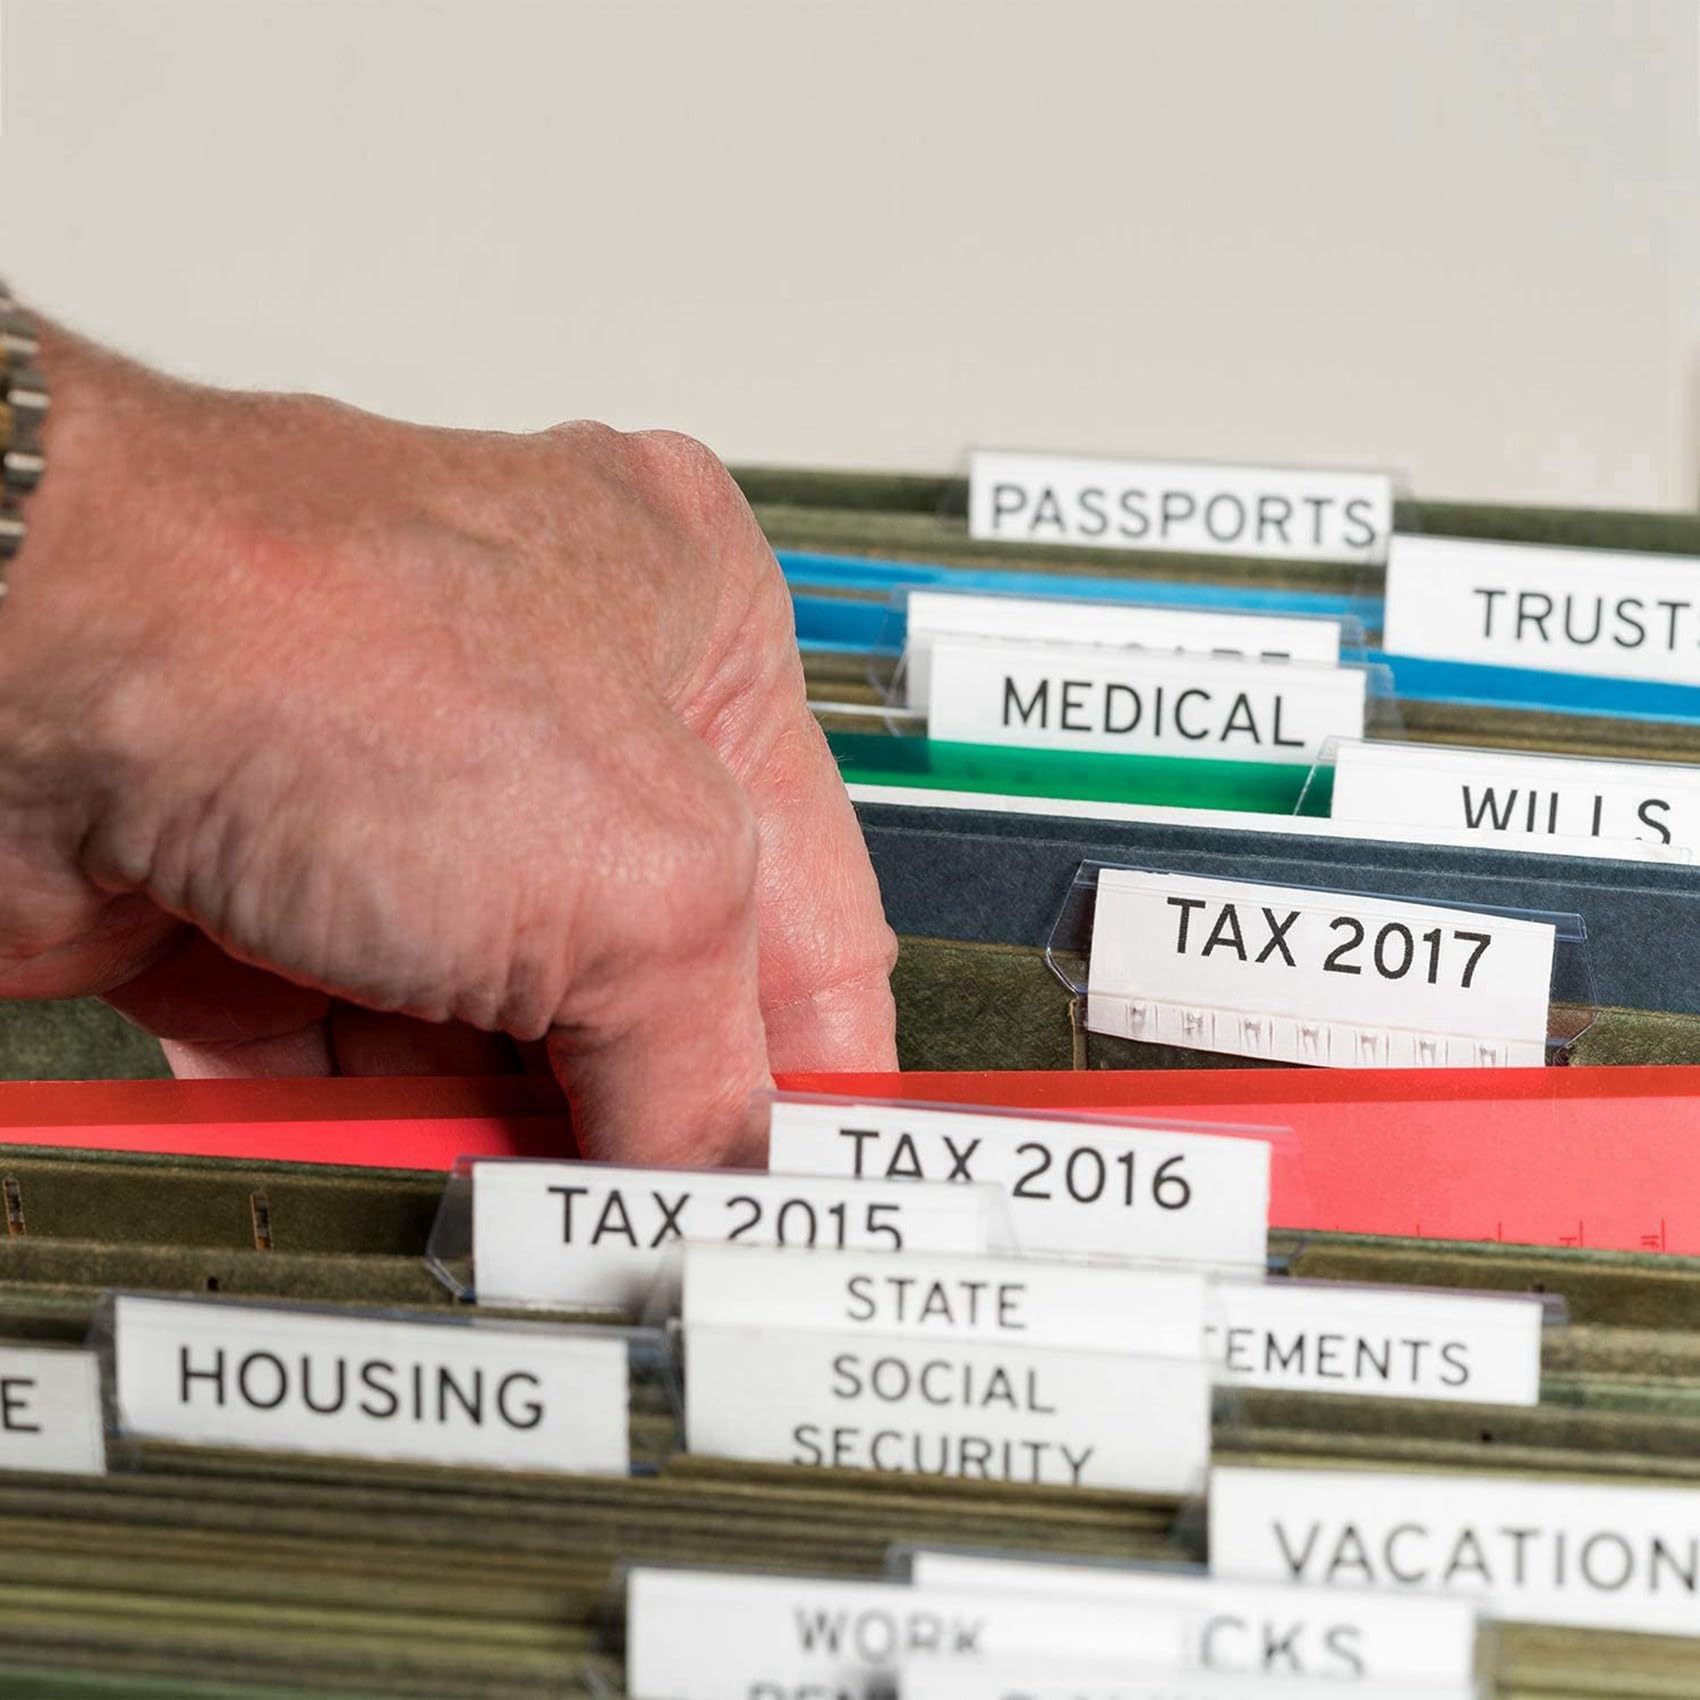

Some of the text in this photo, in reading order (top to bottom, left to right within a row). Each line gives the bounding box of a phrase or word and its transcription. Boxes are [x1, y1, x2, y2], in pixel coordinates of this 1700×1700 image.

[991, 483, 1378, 549] PASSPORTS
[1473, 588, 1700, 651] TRUST
[1001, 676, 1305, 748] MEDICAL
[1166, 896, 1493, 989] TAX 2017
[839, 1129, 1192, 1211] TAX 2016
[547, 1186, 903, 1251] TAX 2015
[845, 1275, 1027, 1329] STATE
[180, 1346, 544, 1430] HOUSING
[832, 1354, 1057, 1413] SOCIAL
[792, 1425, 1094, 1487] SECURITY
[1272, 1521, 1700, 1592] VACATION
